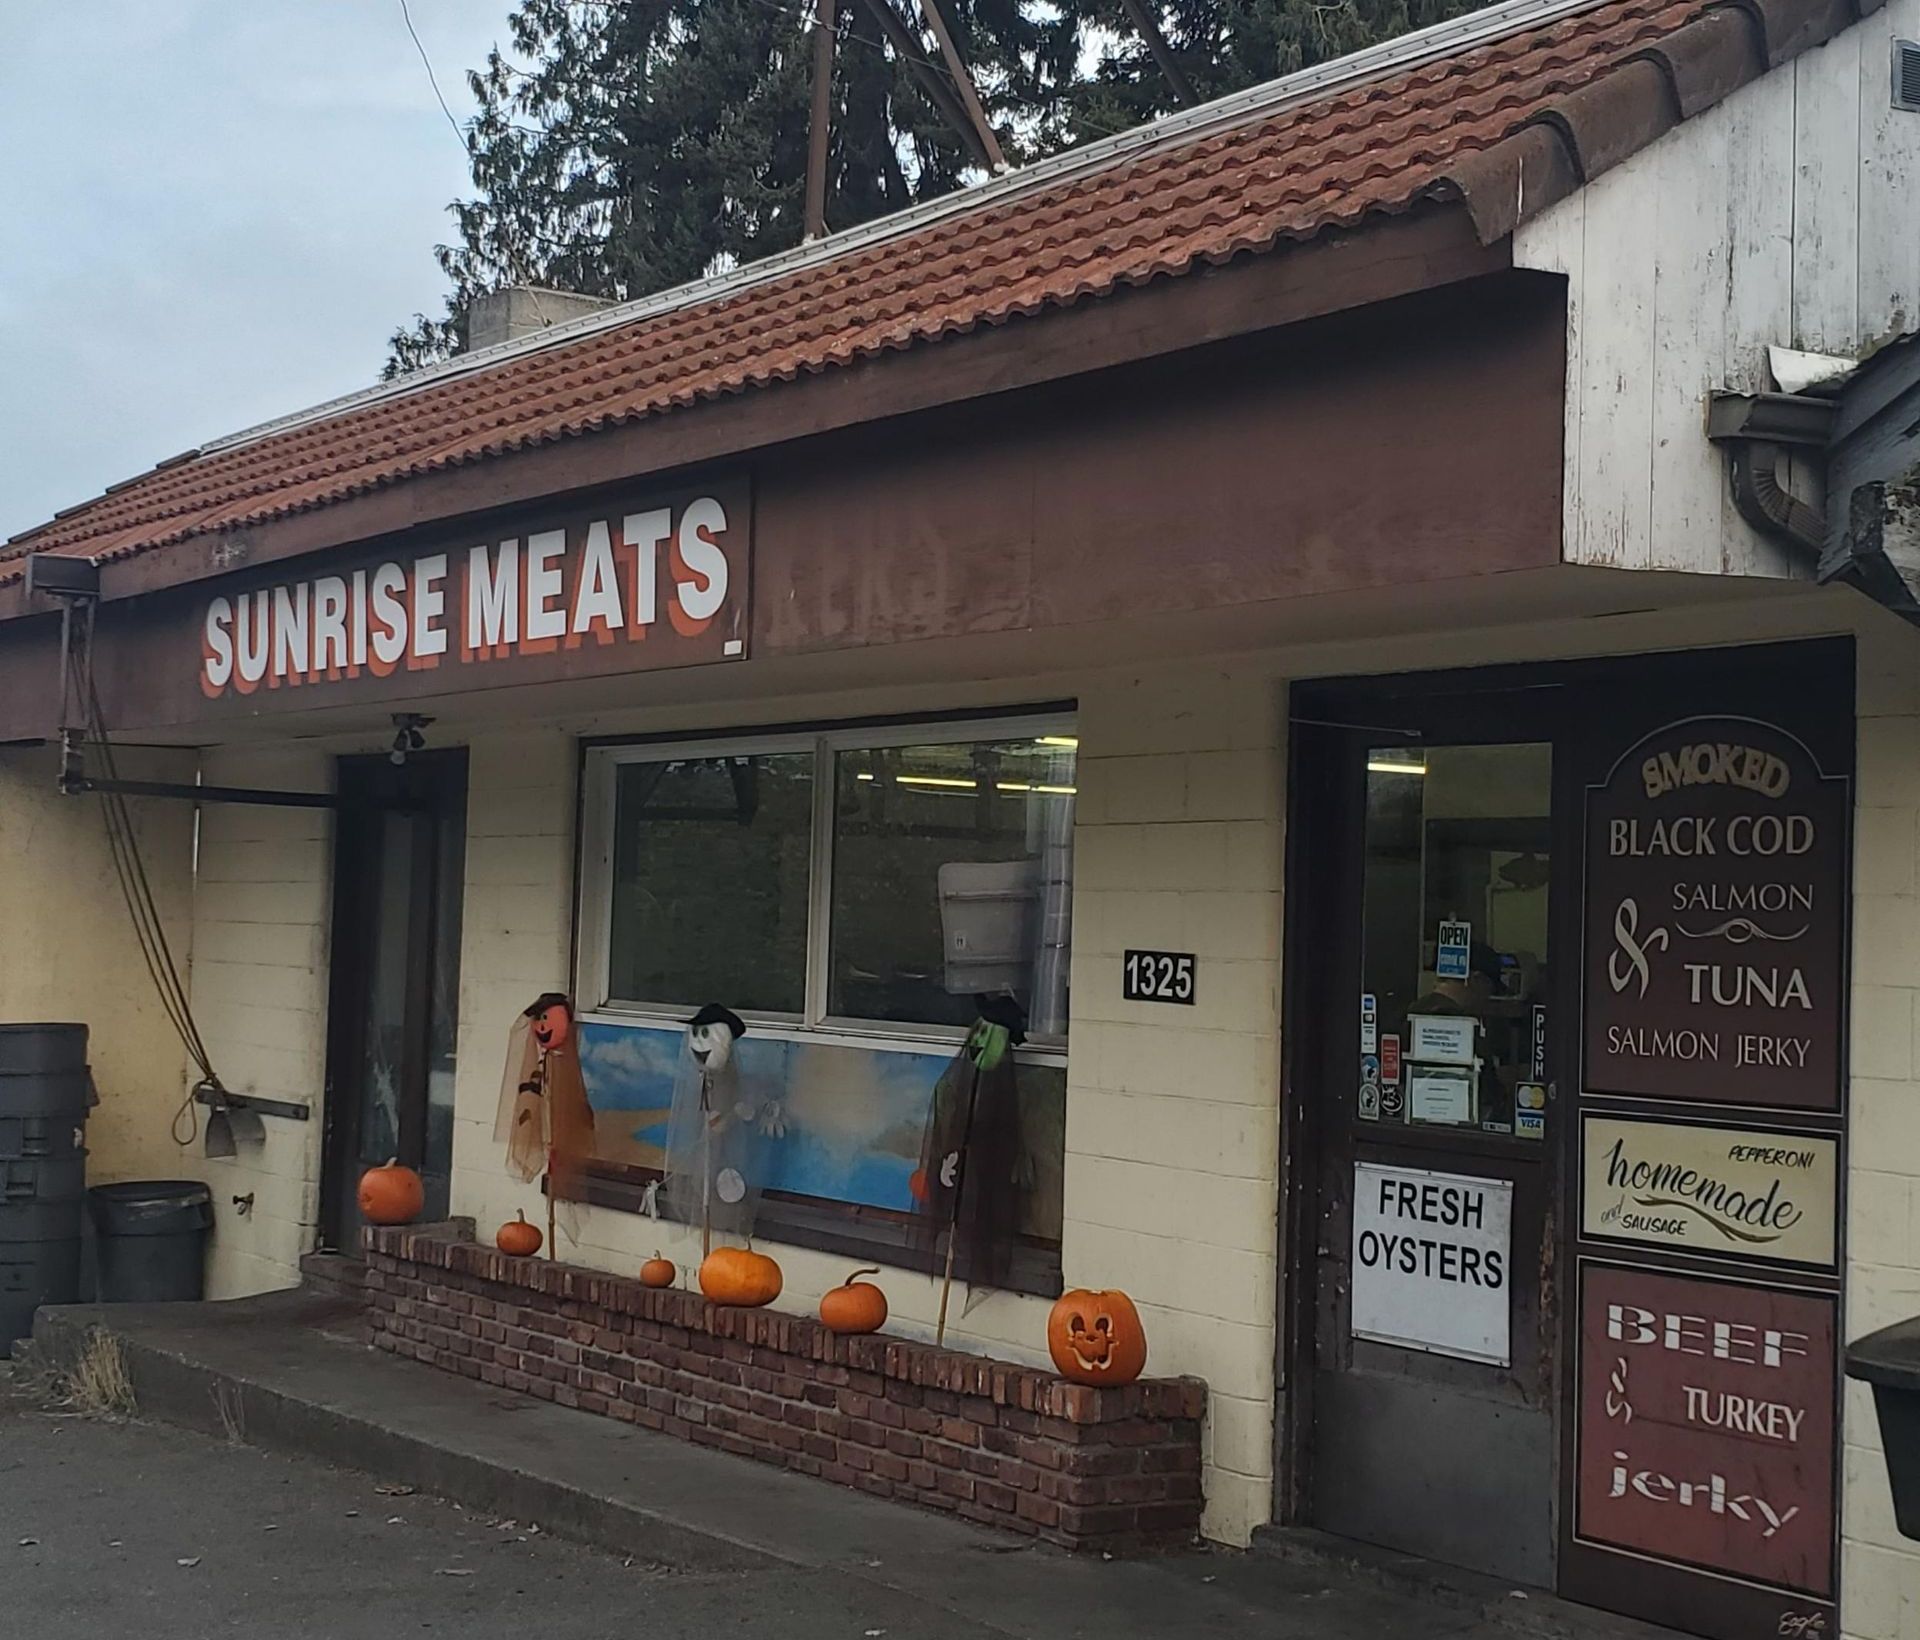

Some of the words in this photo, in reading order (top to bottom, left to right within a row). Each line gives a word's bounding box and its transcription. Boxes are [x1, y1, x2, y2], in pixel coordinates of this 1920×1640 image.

[205, 552, 448, 688] SUNRISE
[467, 495, 728, 649] MEATS
[1641, 743, 1791, 799] SMOKED
[1609, 817, 1717, 857] BLACK
[1727, 815, 1815, 856] COD
[1672, 882, 1814, 912] SALMON
[1440, 926, 1469, 947] OPEN
[1126, 954, 1192, 999] 1325
[1683, 963, 1814, 1010] TUNA
[1534, 1013, 1545, 1077] PUSH
[1606, 1025, 1720, 1062] SALMON
[1734, 1033, 1812, 1068] JERKY
[1520, 1118, 1542, 1129] VISA
[1727, 1144, 1816, 1170] PEPPERONI
[1378, 1178, 1484, 1230] FRESH
[1601, 1137, 1804, 1230] homemade
[1620, 1213, 1689, 1236] SAUSAGE
[1358, 1230, 1503, 1289] OYSTERS
[1606, 1303, 1809, 1368] BEEF
[1682, 1384, 1805, 1443] TURKEY
[1608, 1450, 1800, 1538] jerky
